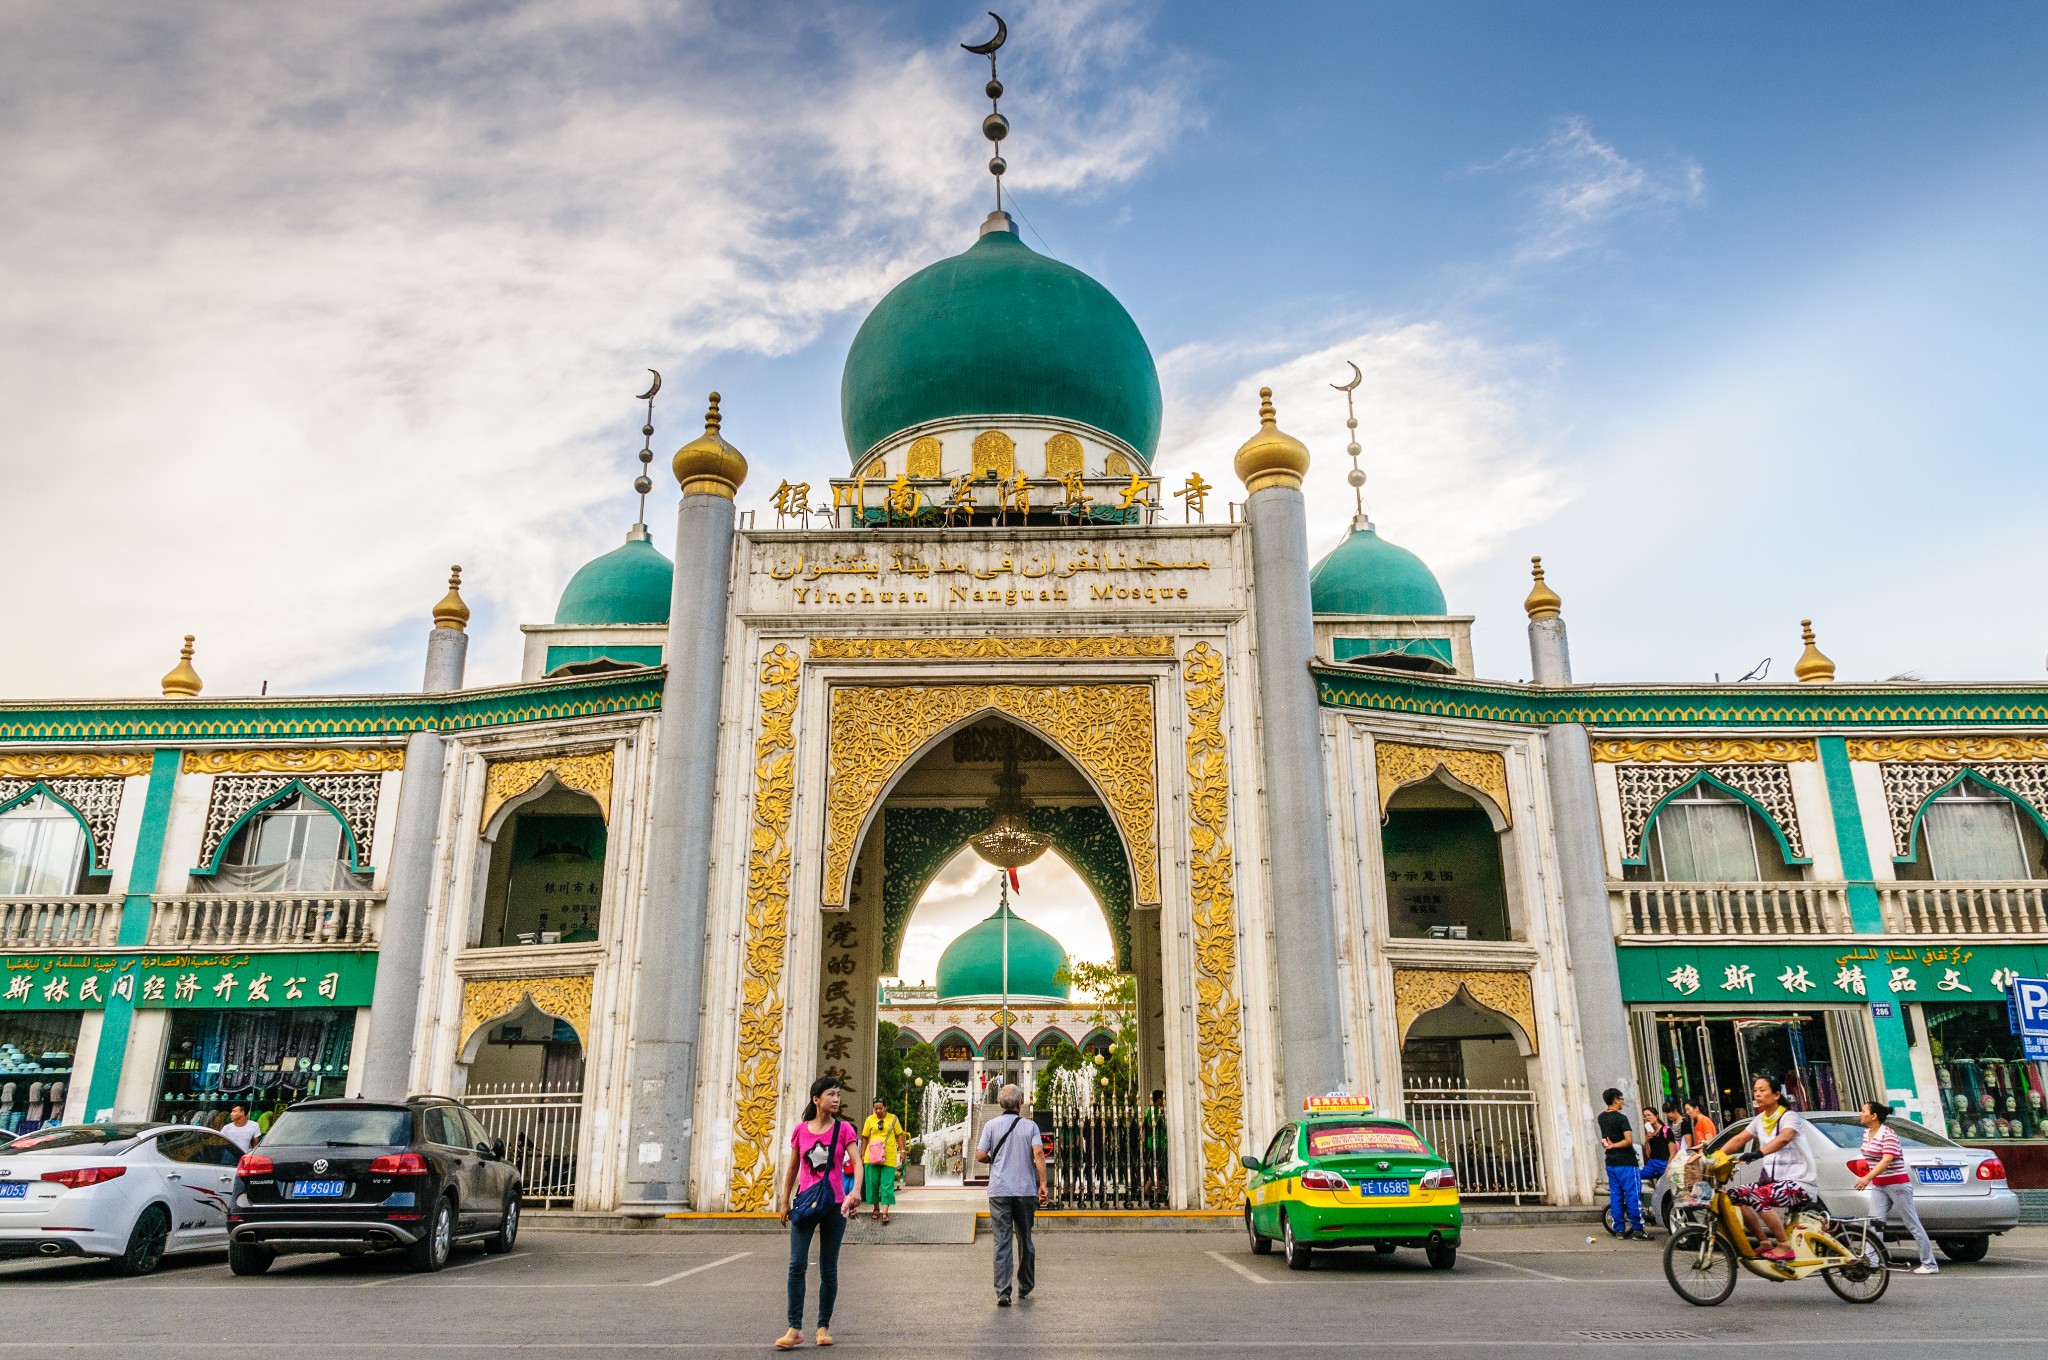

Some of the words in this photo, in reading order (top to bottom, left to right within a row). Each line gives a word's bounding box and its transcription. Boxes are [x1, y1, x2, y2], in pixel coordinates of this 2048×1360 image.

[889, 551, 966, 579] مدينة
[1130, 556, 1211, 576] مسجد
[793, 586, 928, 604] Yinchuan
[949, 585, 1068, 606] Nanguan
[1090, 583, 1190, 604] Mosque
[2, 972, 340, 1004] 斯林民间经济开发公司
[1666, 964, 2048, 996] 穆斯林精品文化
[2020, 984, 2048, 1020] P
[0, 1184, 28, 1196] W053
